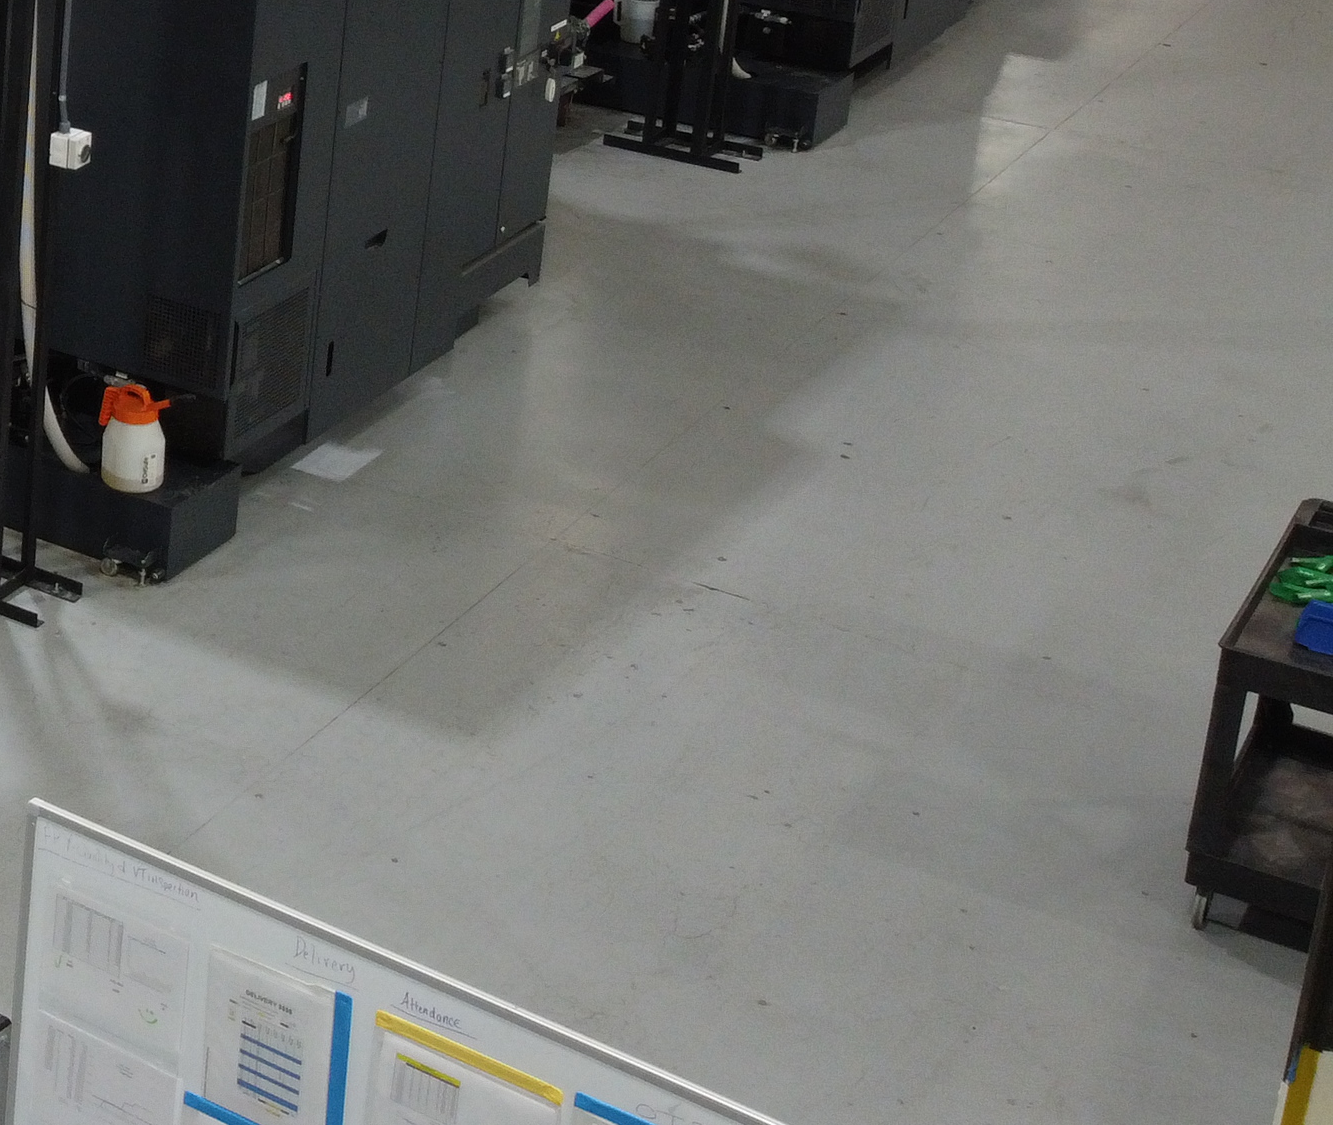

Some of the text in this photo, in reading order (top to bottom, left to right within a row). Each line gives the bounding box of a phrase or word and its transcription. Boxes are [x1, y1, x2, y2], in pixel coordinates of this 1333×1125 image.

[293, 935, 356, 984] Delivery
[245, 989, 278, 1008] DELIVERY
[400, 991, 463, 1030] Attendance
